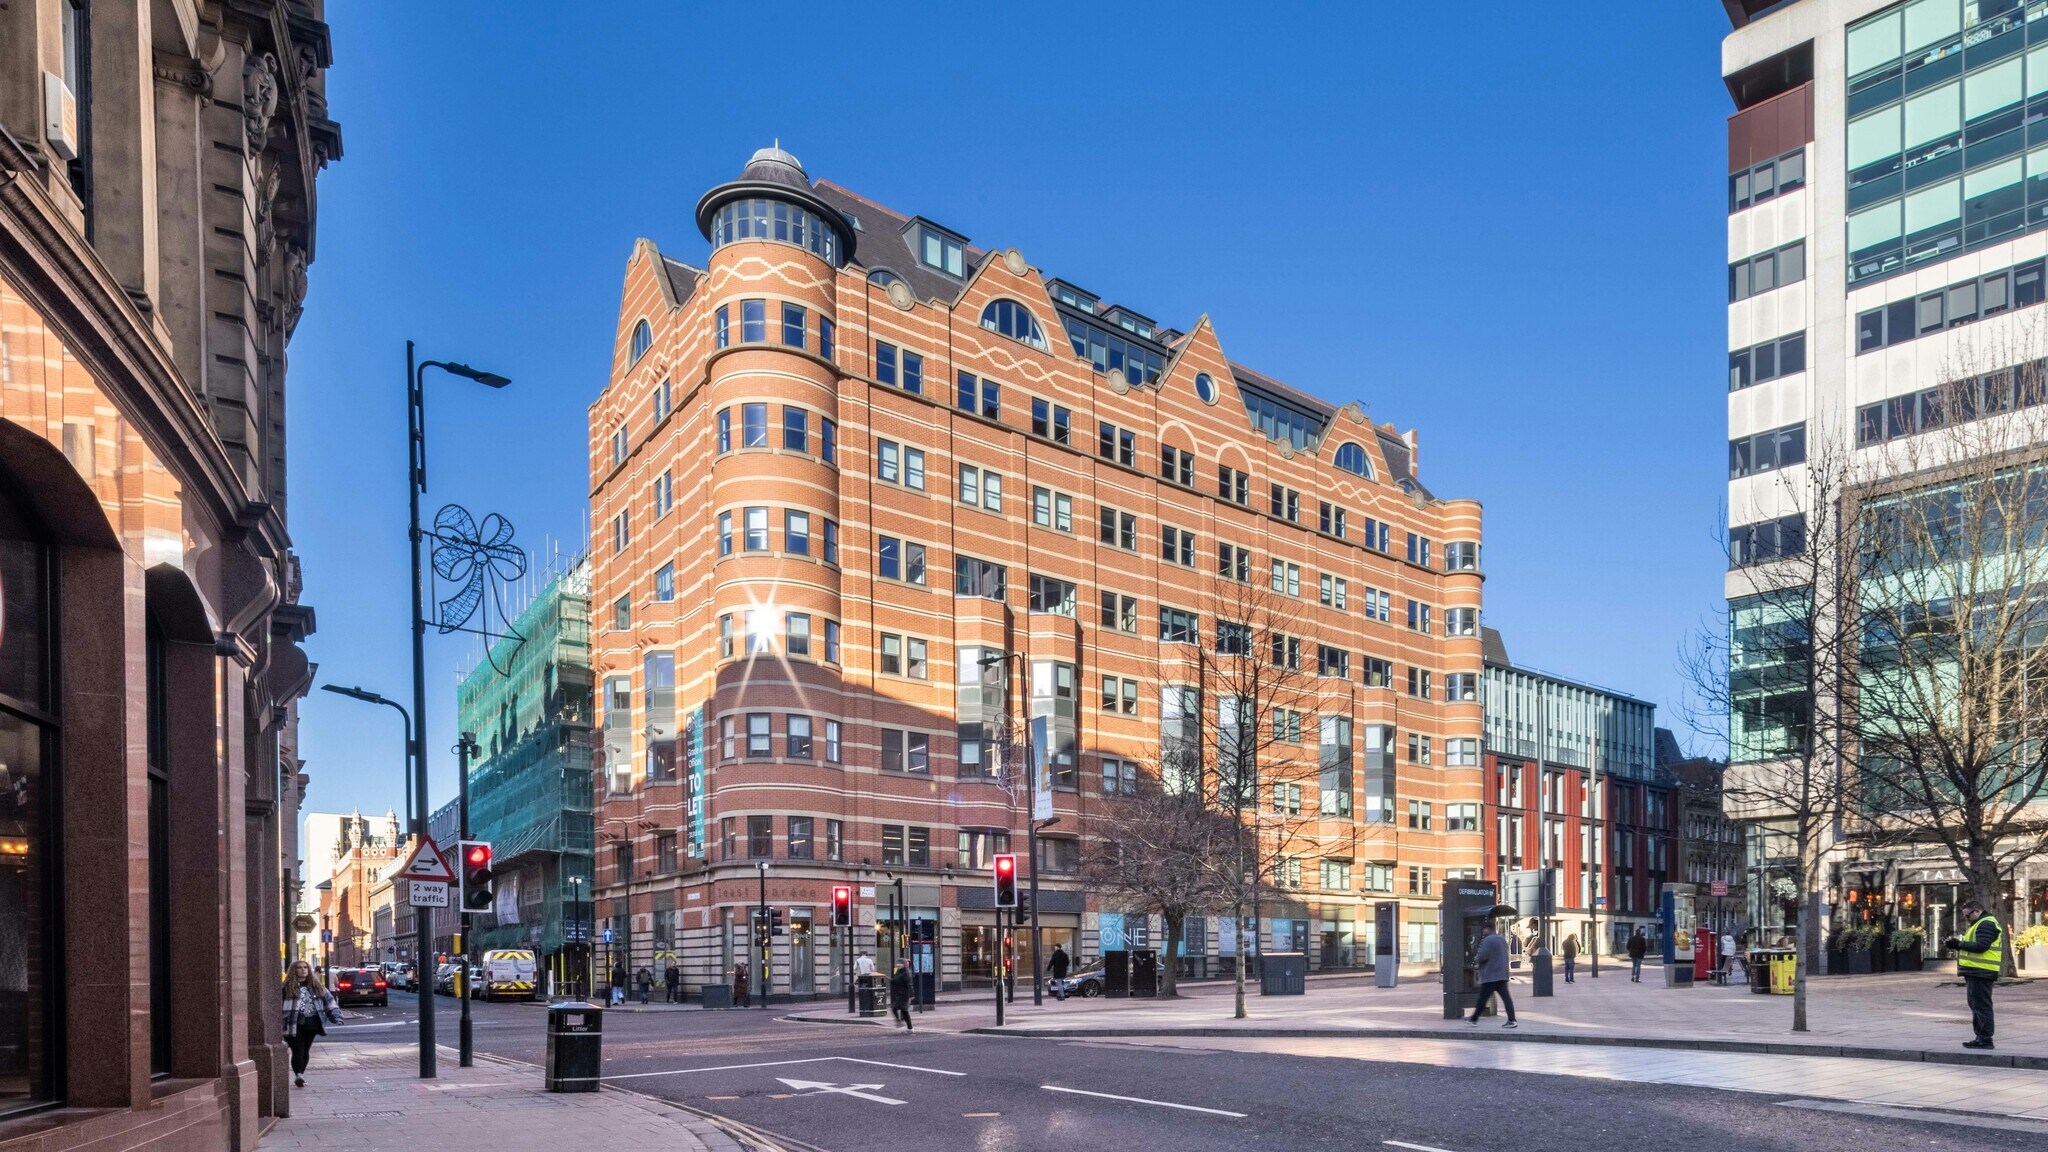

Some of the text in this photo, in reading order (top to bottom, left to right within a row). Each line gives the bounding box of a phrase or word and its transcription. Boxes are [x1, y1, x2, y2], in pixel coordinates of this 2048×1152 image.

[688, 772, 702, 793] TO
[687, 794, 704, 816] LET
[413, 883, 420, 891] 2
[413, 894, 445, 903] traffic
[1274, 920, 1288, 929] ONE
[1101, 927, 1146, 946] ONE
